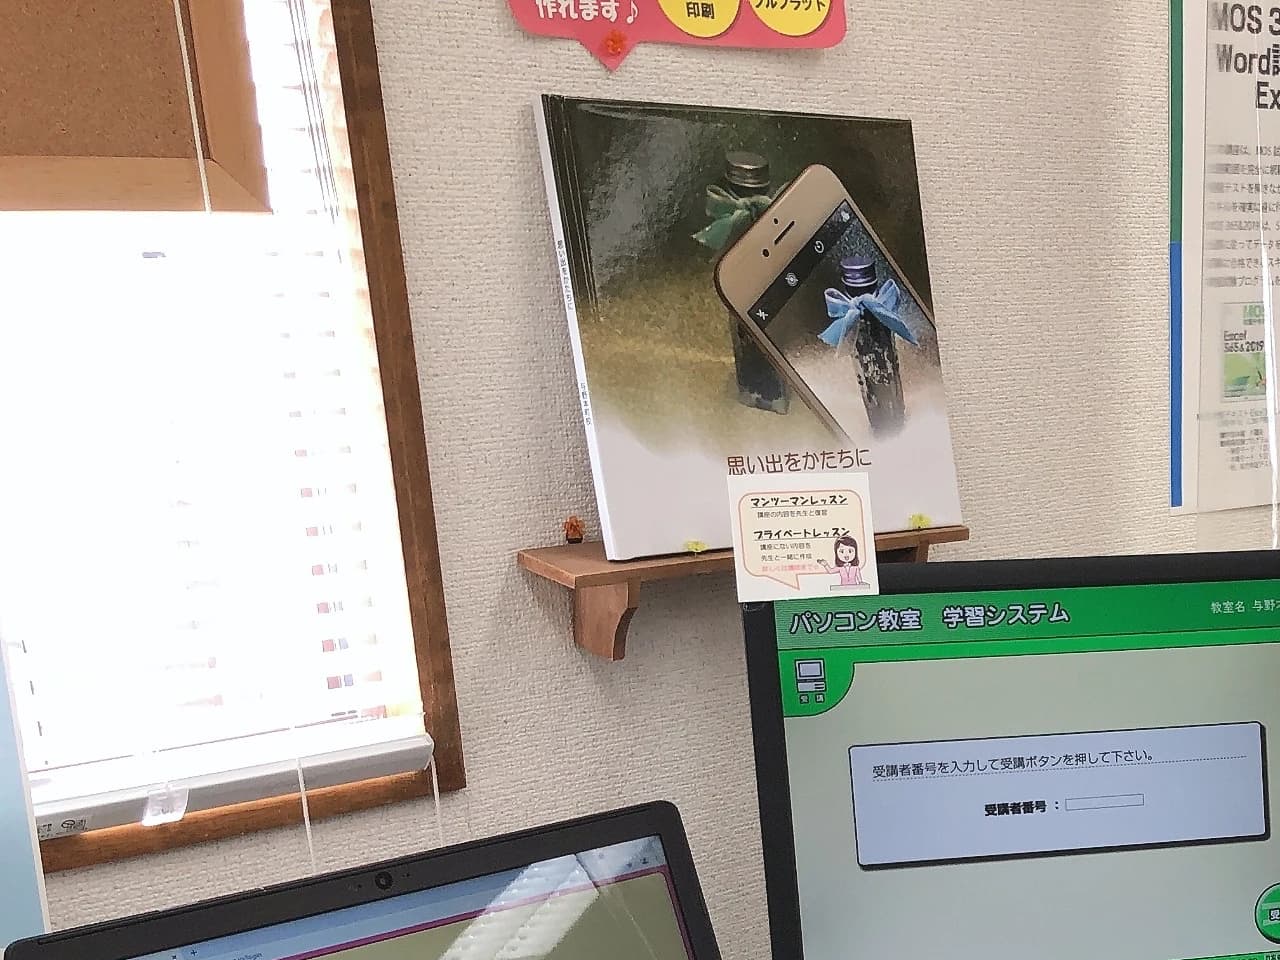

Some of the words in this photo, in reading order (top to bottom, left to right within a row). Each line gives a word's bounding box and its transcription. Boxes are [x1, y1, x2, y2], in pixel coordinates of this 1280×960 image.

[727, 448, 872, 476] 思い出をかたちに
[750, 494, 848, 507] マンツーマンレッスン
[789, 609, 922, 634] パソコン教室
[943, 604, 1070, 628] 学習システム
[1210, 600, 1246, 614] 教室名
[872, 750, 1154, 779] 受講者番号を入力して受講ボタンを押して下さい。
